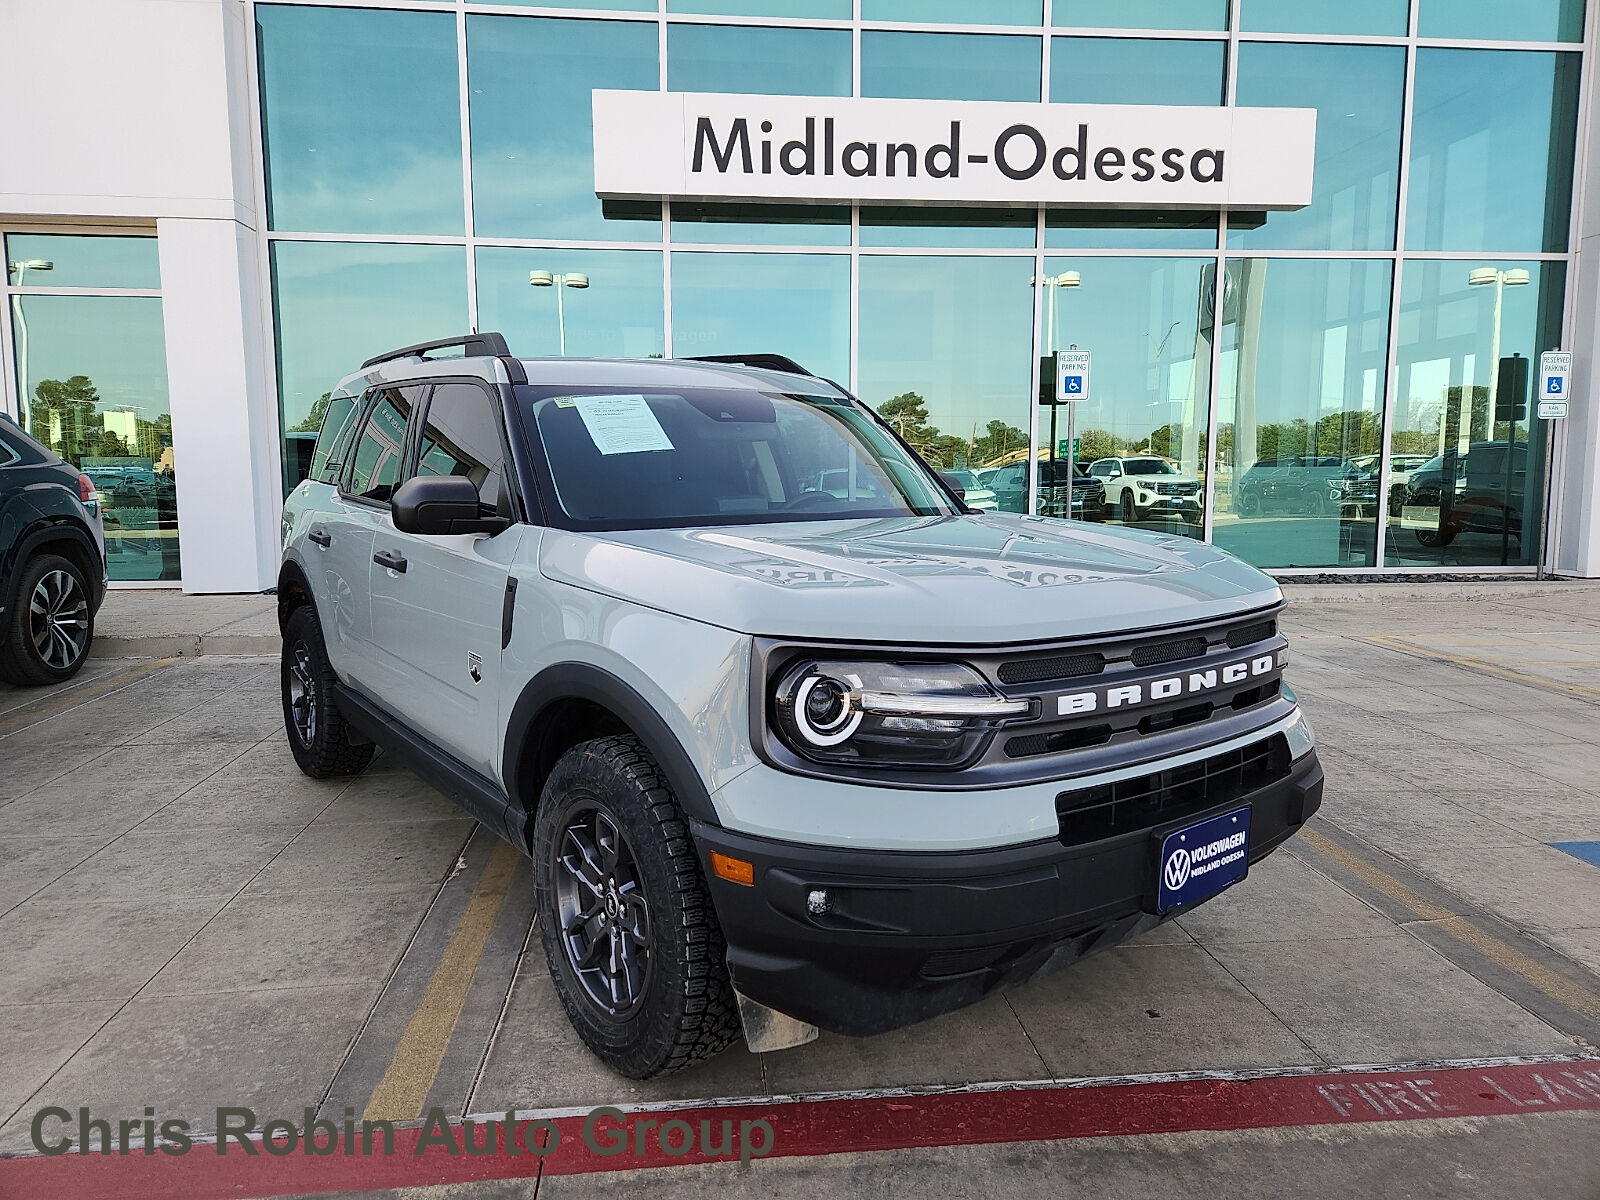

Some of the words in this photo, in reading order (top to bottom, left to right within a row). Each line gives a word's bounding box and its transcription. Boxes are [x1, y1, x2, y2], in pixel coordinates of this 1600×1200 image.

[691, 116, 1225, 183] Midland-Odessa
[1057, 655, 1273, 716] BRONCO
[1190, 831, 1246, 864] VOLKSWAGEN
[1190, 860, 1221, 878] MIDLAND
[1221, 849, 1245, 866] ODESSA
[1316, 1078, 1460, 1118] FIRE
